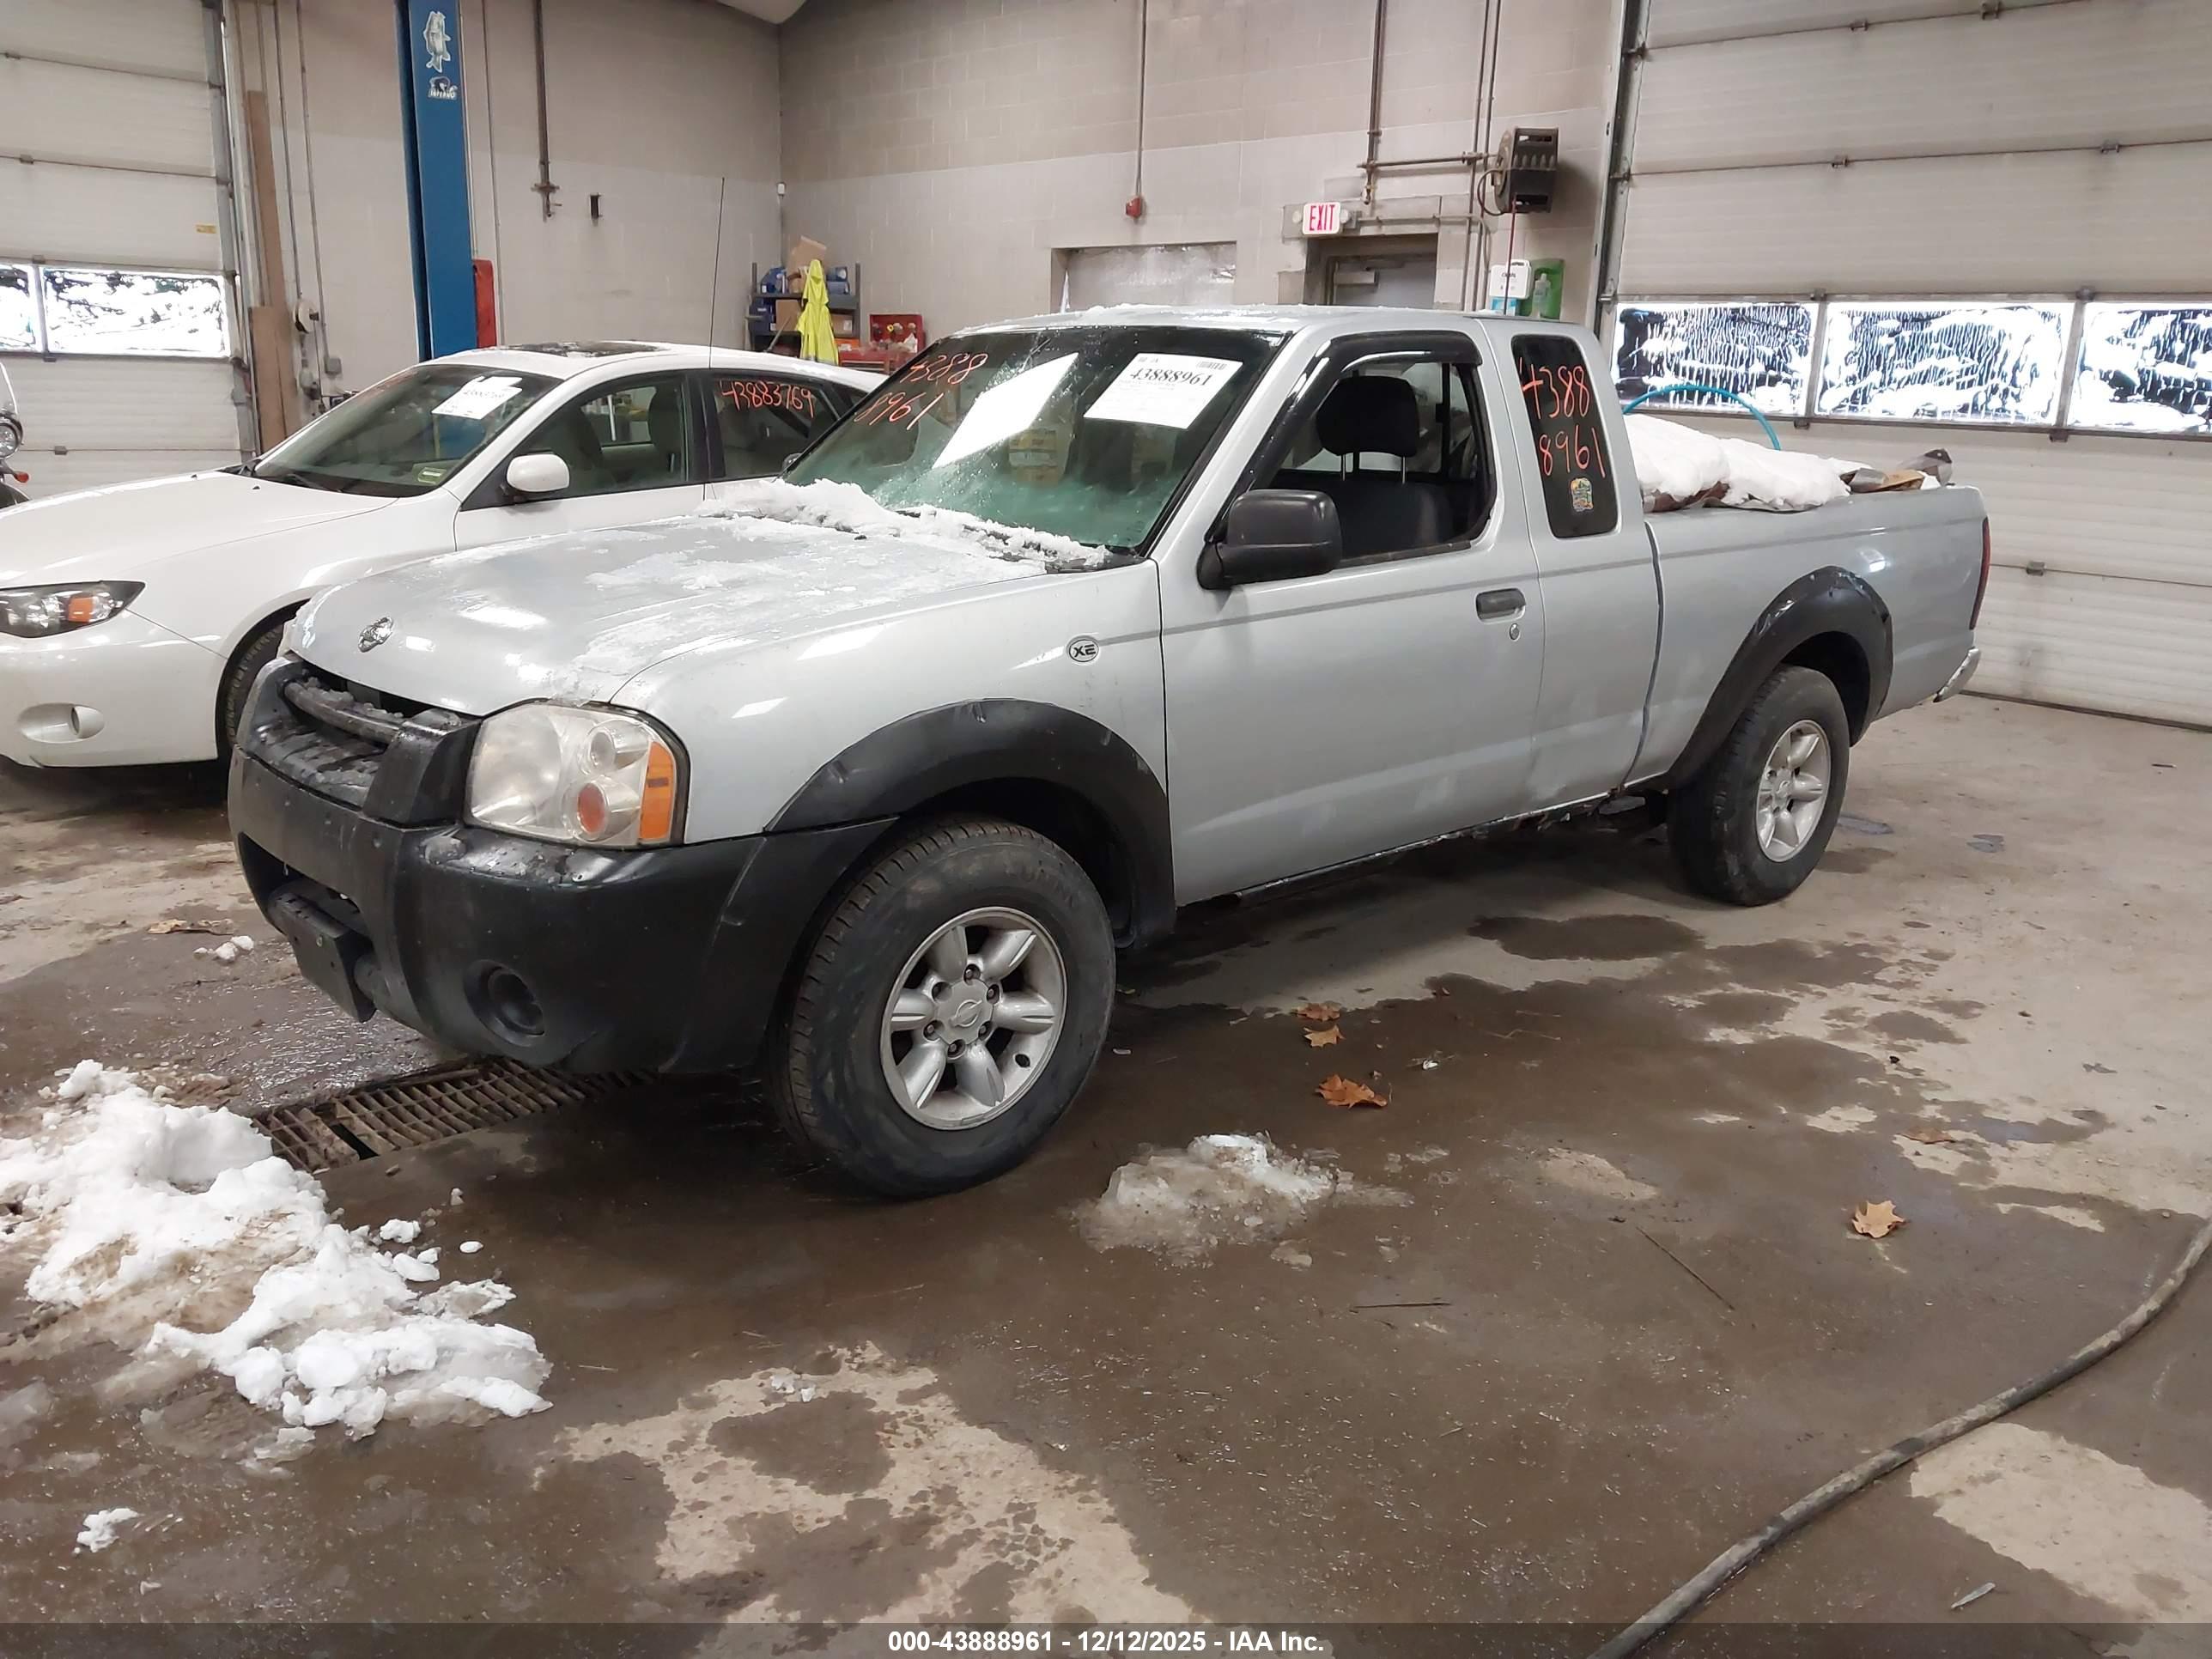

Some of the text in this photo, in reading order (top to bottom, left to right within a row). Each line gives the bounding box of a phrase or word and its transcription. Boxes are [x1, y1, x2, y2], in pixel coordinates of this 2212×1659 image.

[1310, 204, 1335, 231] EXIT
[1130, 368, 1213, 386] 43888961
[1519, 356, 1589, 419] 4388
[720, 380, 814, 418] 43883769
[854, 392, 945, 430] 8961
[1539, 424, 1606, 478] 8961
[1073, 644, 1097, 658] XE
